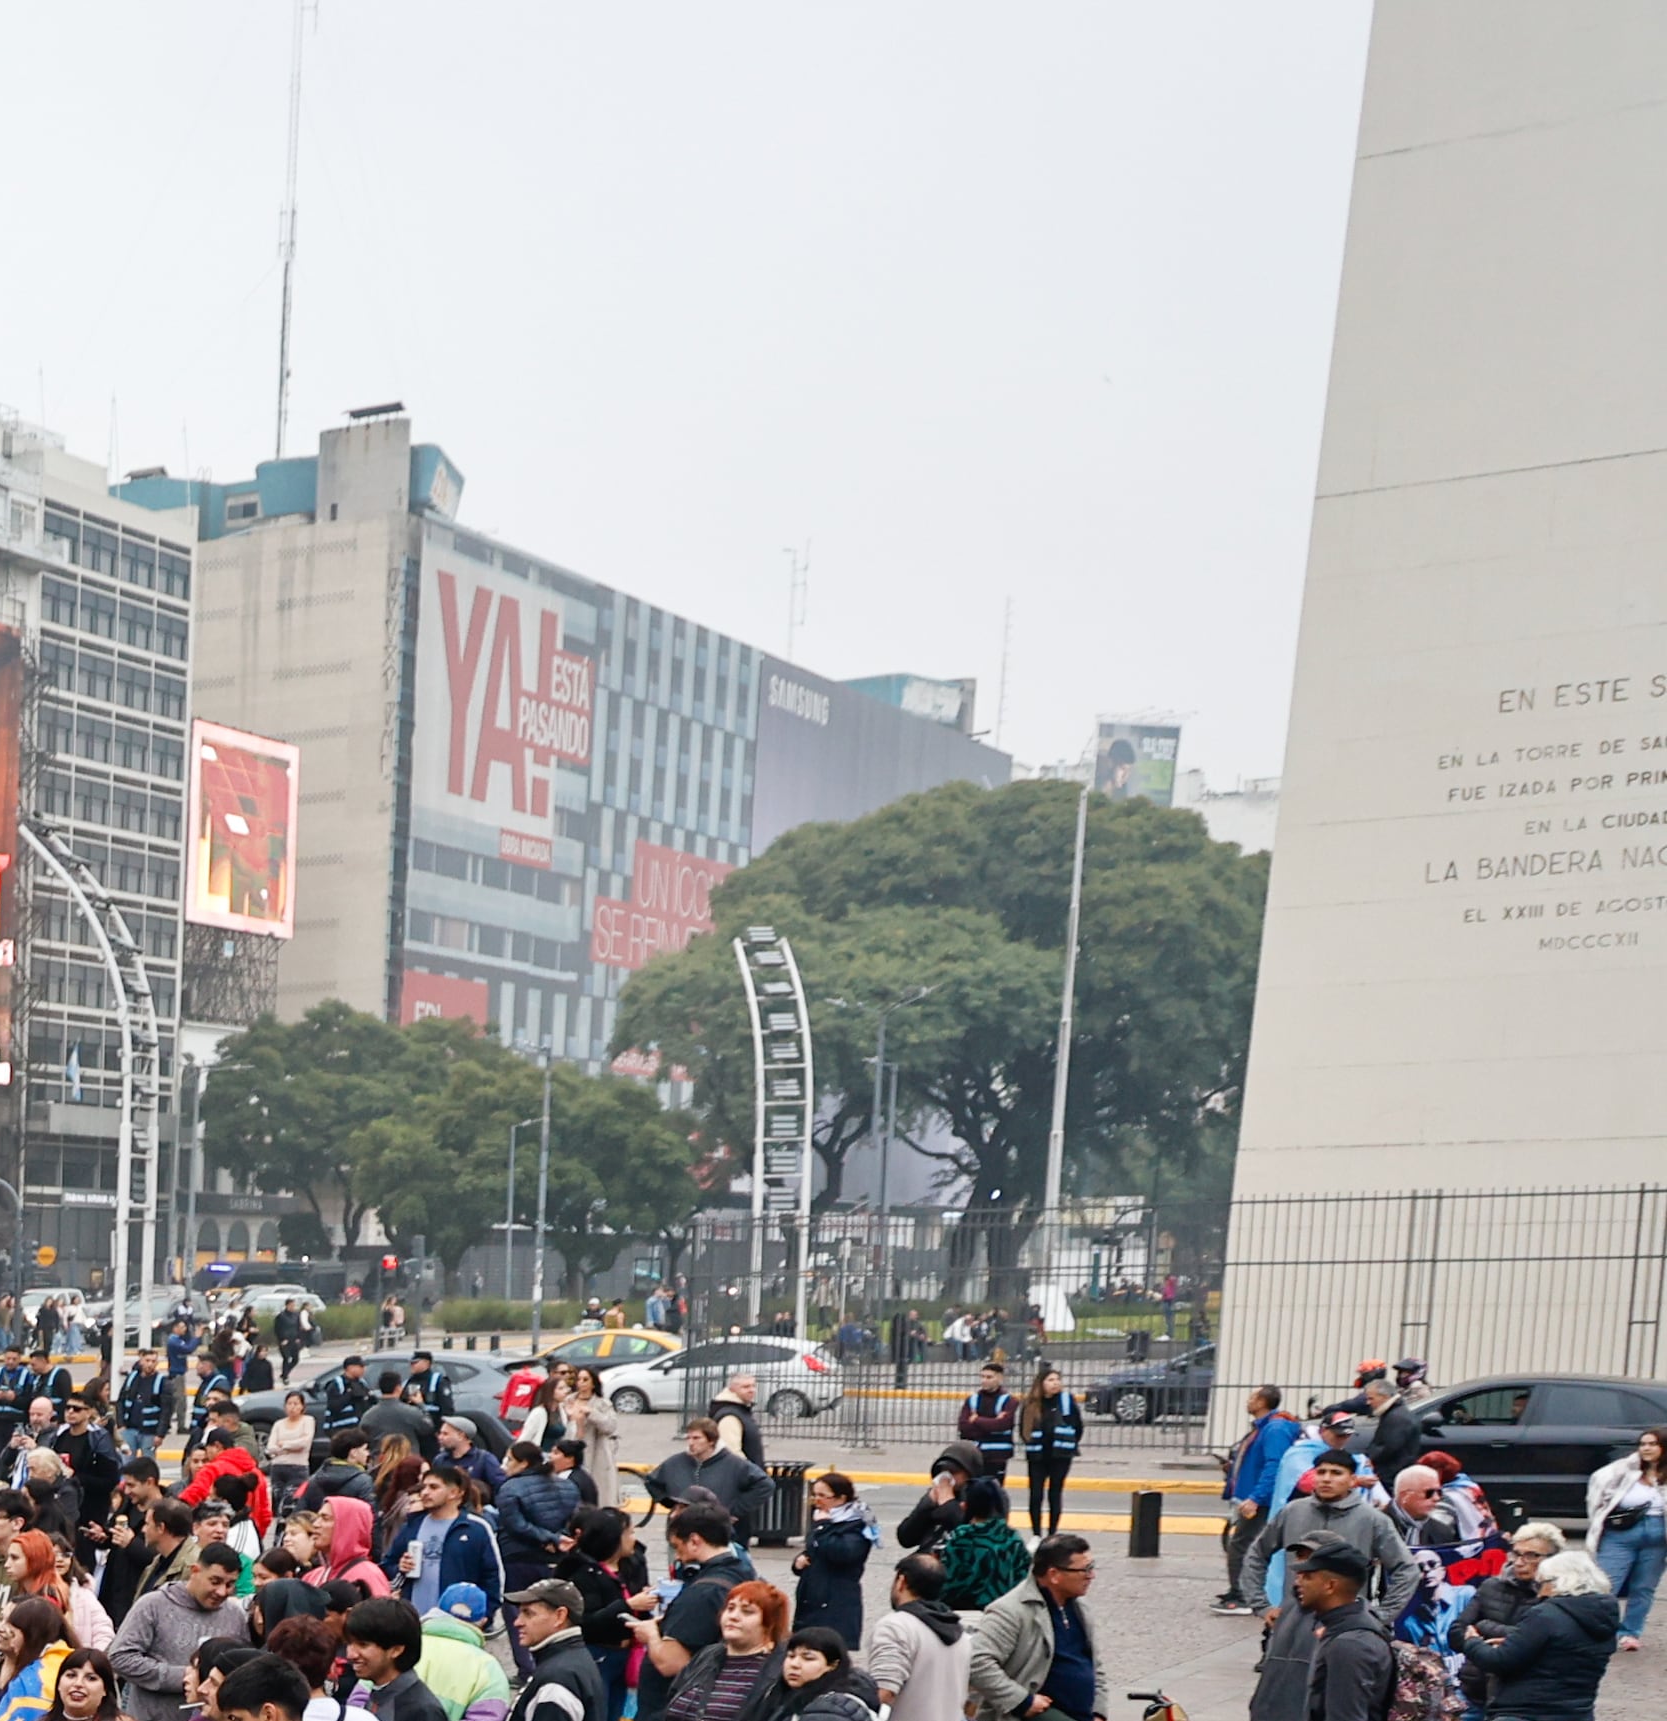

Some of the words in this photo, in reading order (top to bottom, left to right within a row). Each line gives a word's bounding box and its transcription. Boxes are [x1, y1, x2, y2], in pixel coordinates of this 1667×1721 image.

[551, 655, 590, 711] ESTÁ
[769, 674, 830, 726] SAMSUNG
[1498, 688, 1536, 713] EN
[1554, 678, 1631, 707] ESTE
[518, 697, 589, 758] PASANDO
[1437, 754, 1463, 770] EN
[1476, 751, 1500, 766] LA
[1516, 743, 1583, 762] TORRE
[1599, 738, 1626, 755] DE
[1448, 785, 1486, 802] FUE
[1499, 780, 1556, 798] IZADA
[1570, 774, 1614, 792] POR
[1524, 819, 1551, 835] EN
[1564, 816, 1587, 832] LA
[1424, 860, 1458, 884] LA
[1476, 850, 1603, 880] BANDERA
[639, 858, 666, 911] UN
[1463, 908, 1486, 923] EL
[1502, 904, 1544, 920] XXIII
[1556, 901, 1582, 917] DE
[1595, 896, 1667, 914] AGOST
[596, 905, 625, 960] SE
[1538, 932, 1639, 951] MDCCCXII
